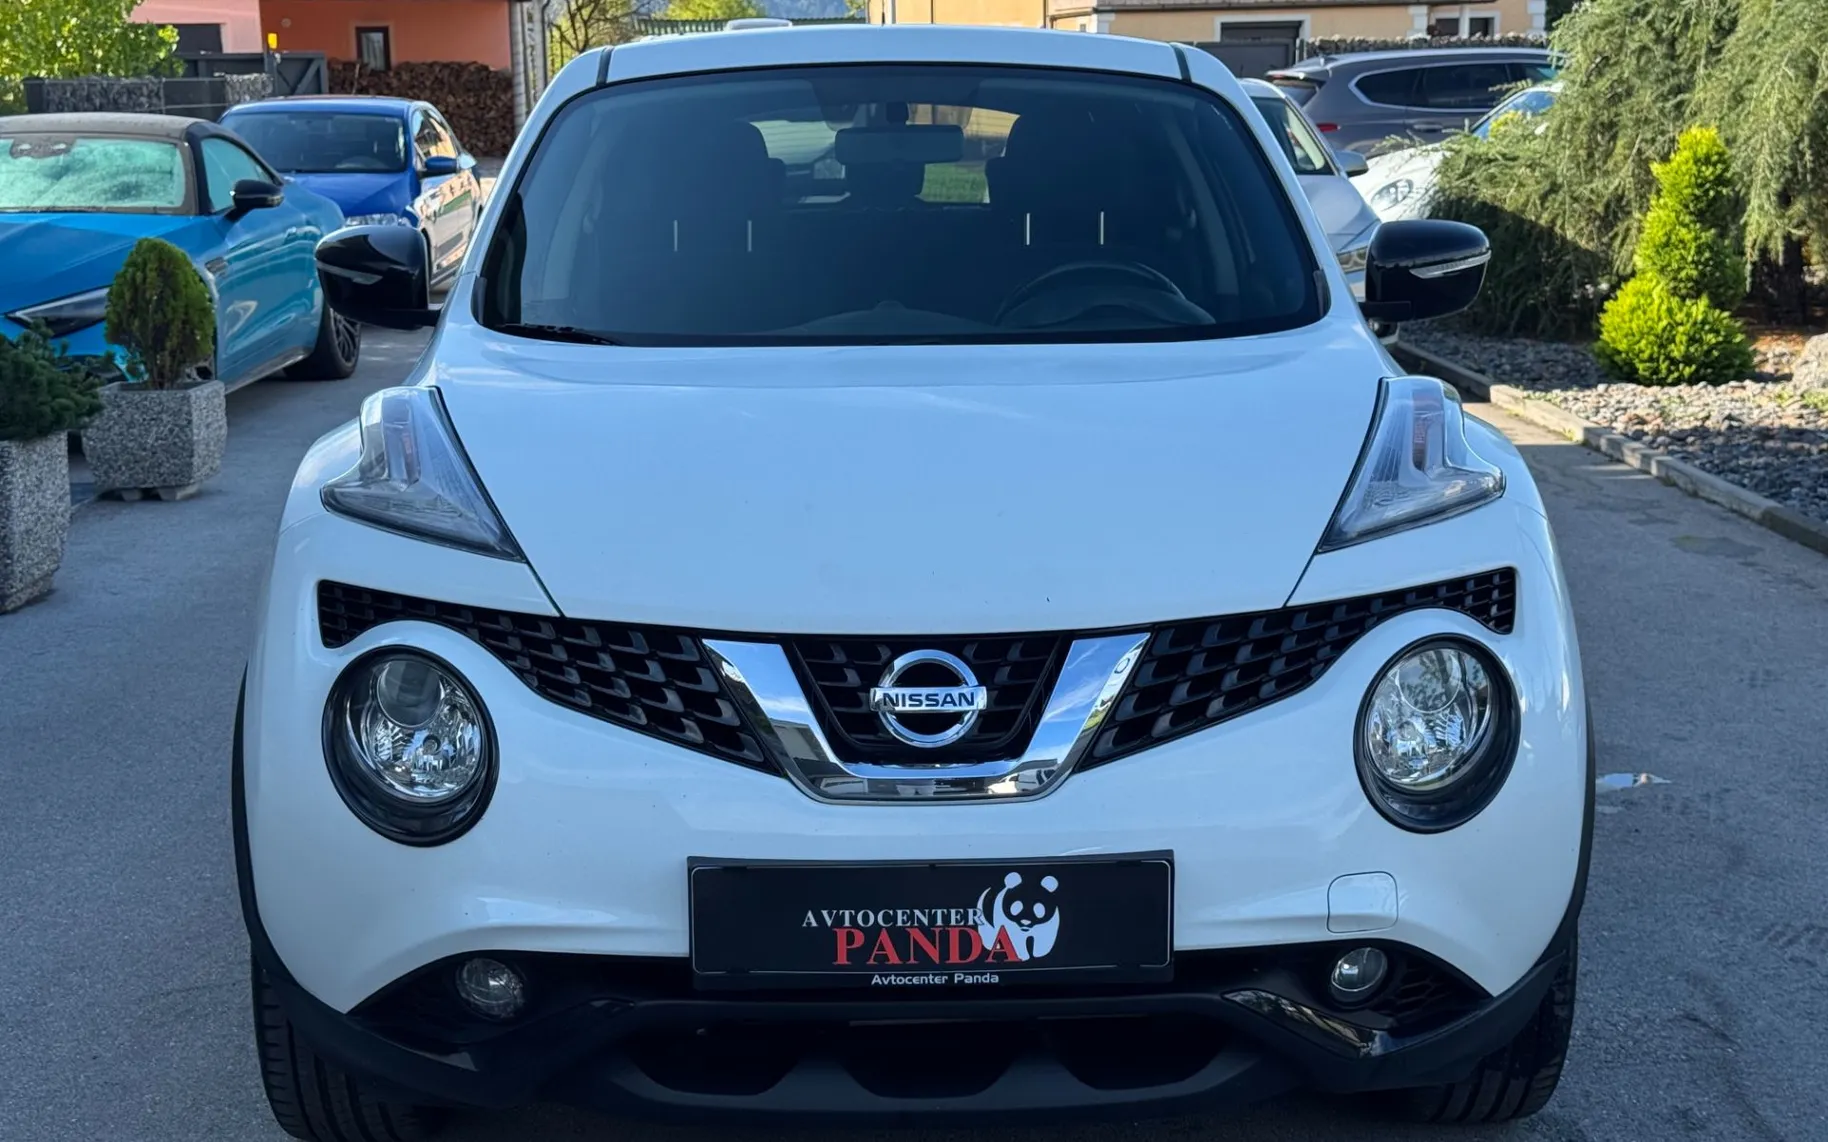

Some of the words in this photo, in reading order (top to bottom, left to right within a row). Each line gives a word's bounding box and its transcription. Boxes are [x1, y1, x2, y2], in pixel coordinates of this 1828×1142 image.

[882, 692, 975, 708] NISSAN
[802, 907, 985, 928] AVTOCENTER
[832, 925, 1023, 965] PANDA
[871, 973, 948, 985] Avtocenter
[953, 972, 1000, 984] Panda
